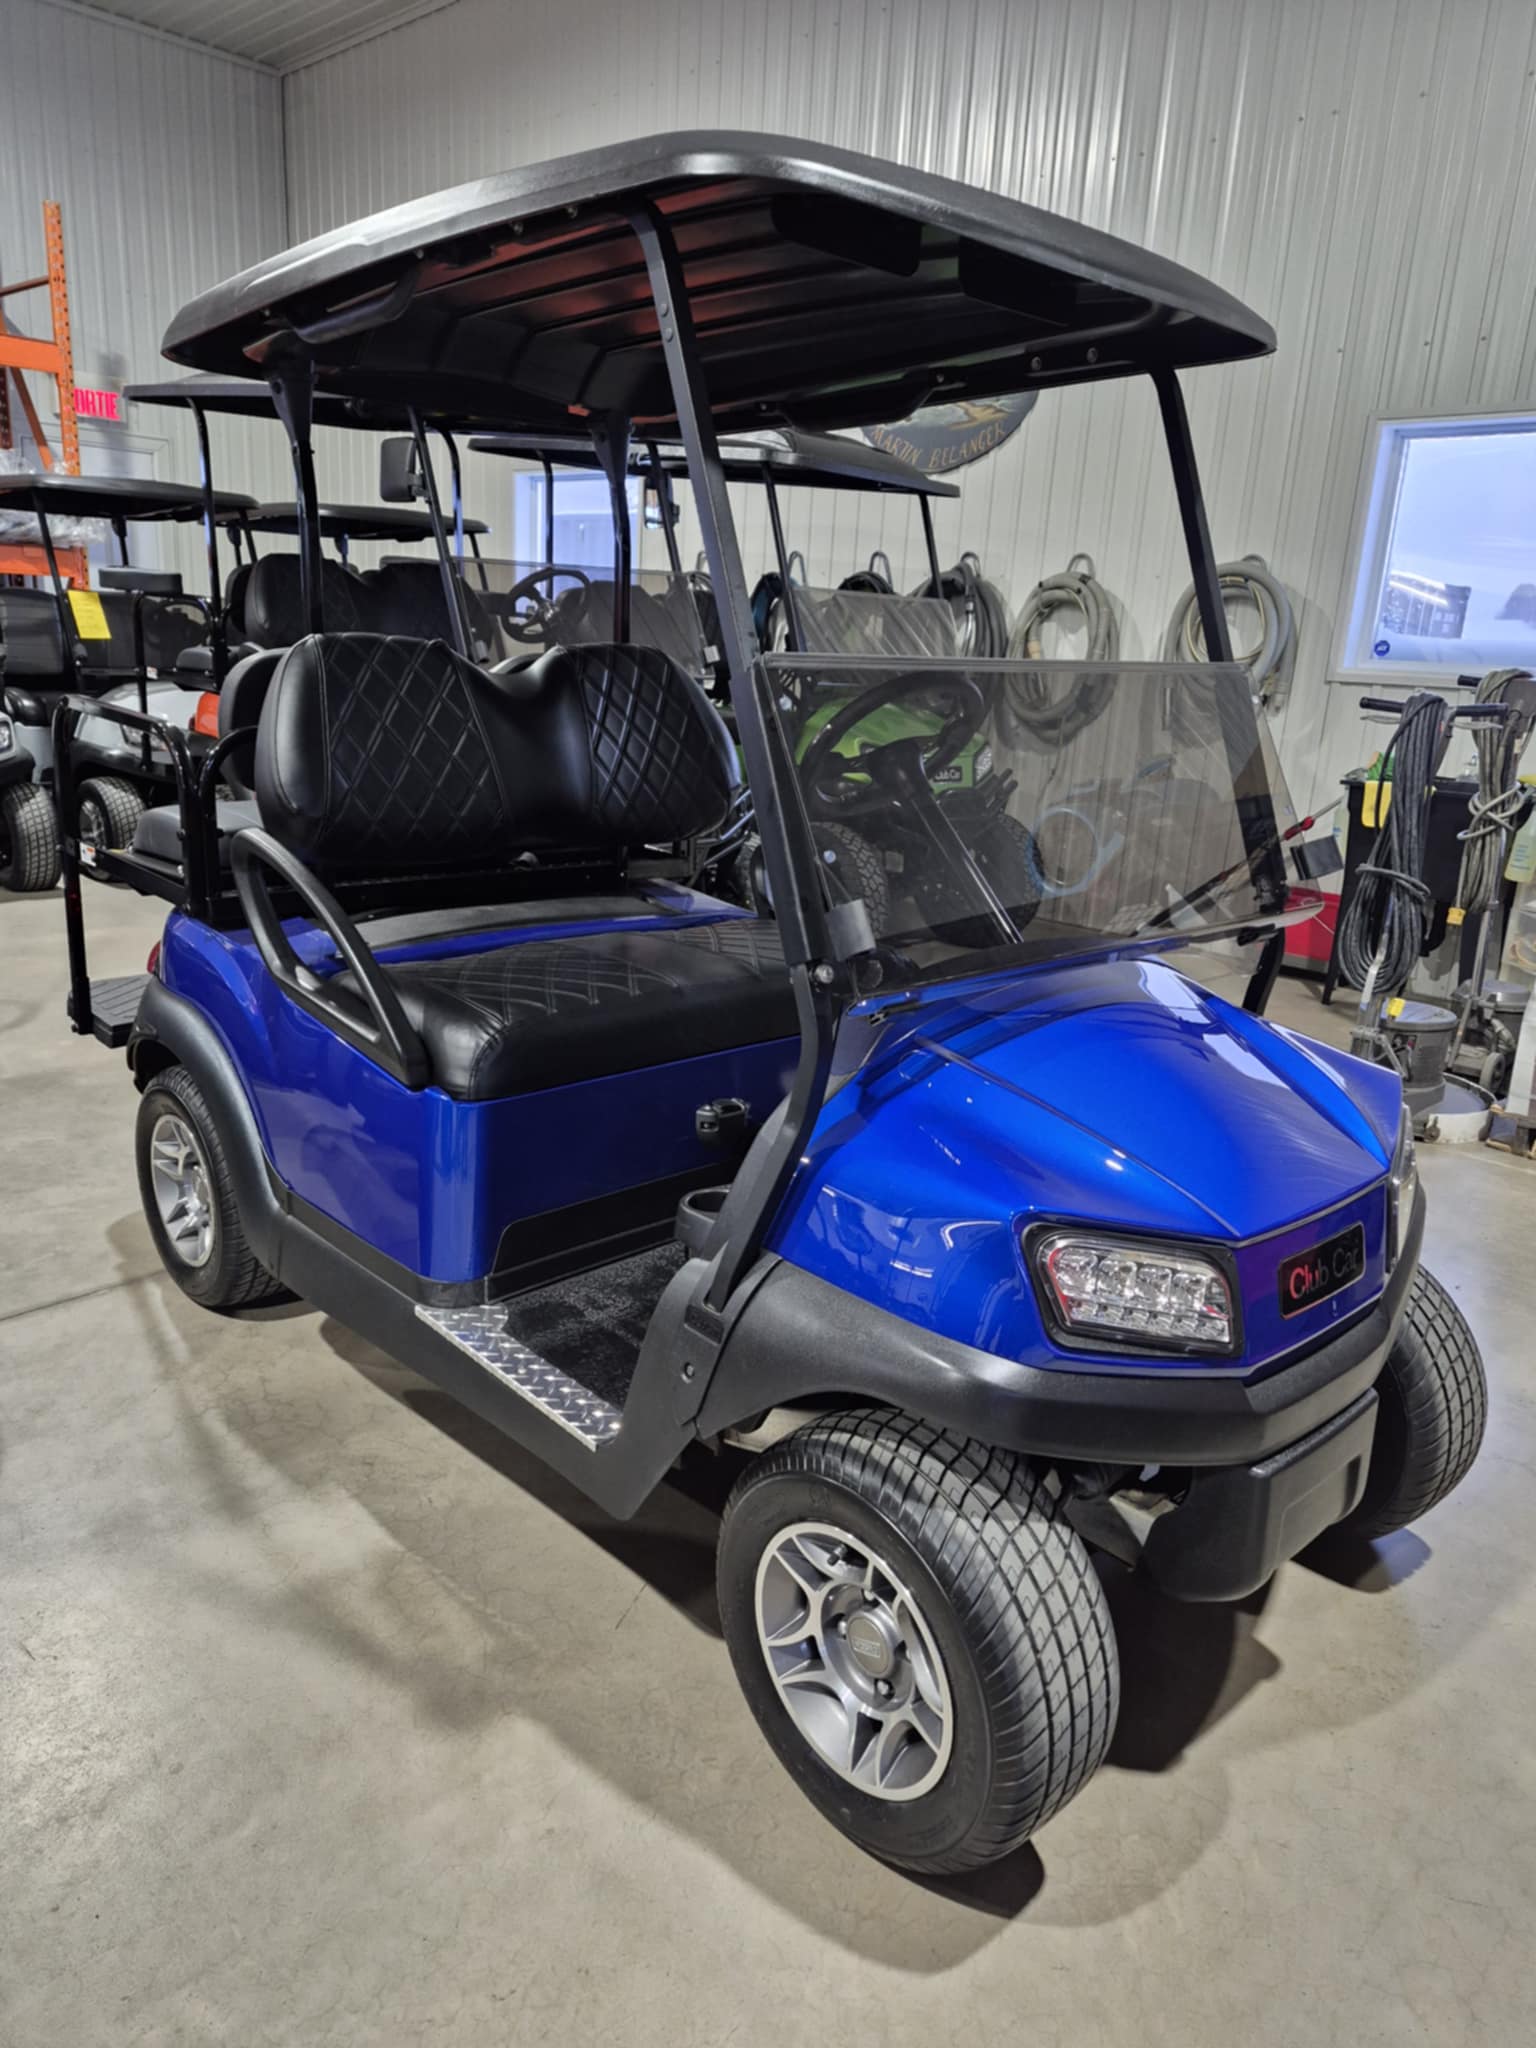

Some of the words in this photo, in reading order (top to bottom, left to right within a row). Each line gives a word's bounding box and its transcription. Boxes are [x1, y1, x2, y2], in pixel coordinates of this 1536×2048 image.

[73, 387, 121, 421] ORTIE
[928, 421, 1006, 469] BELANGER
[1289, 1257, 1329, 1300] Club
[1332, 1247, 1359, 1278] Car
